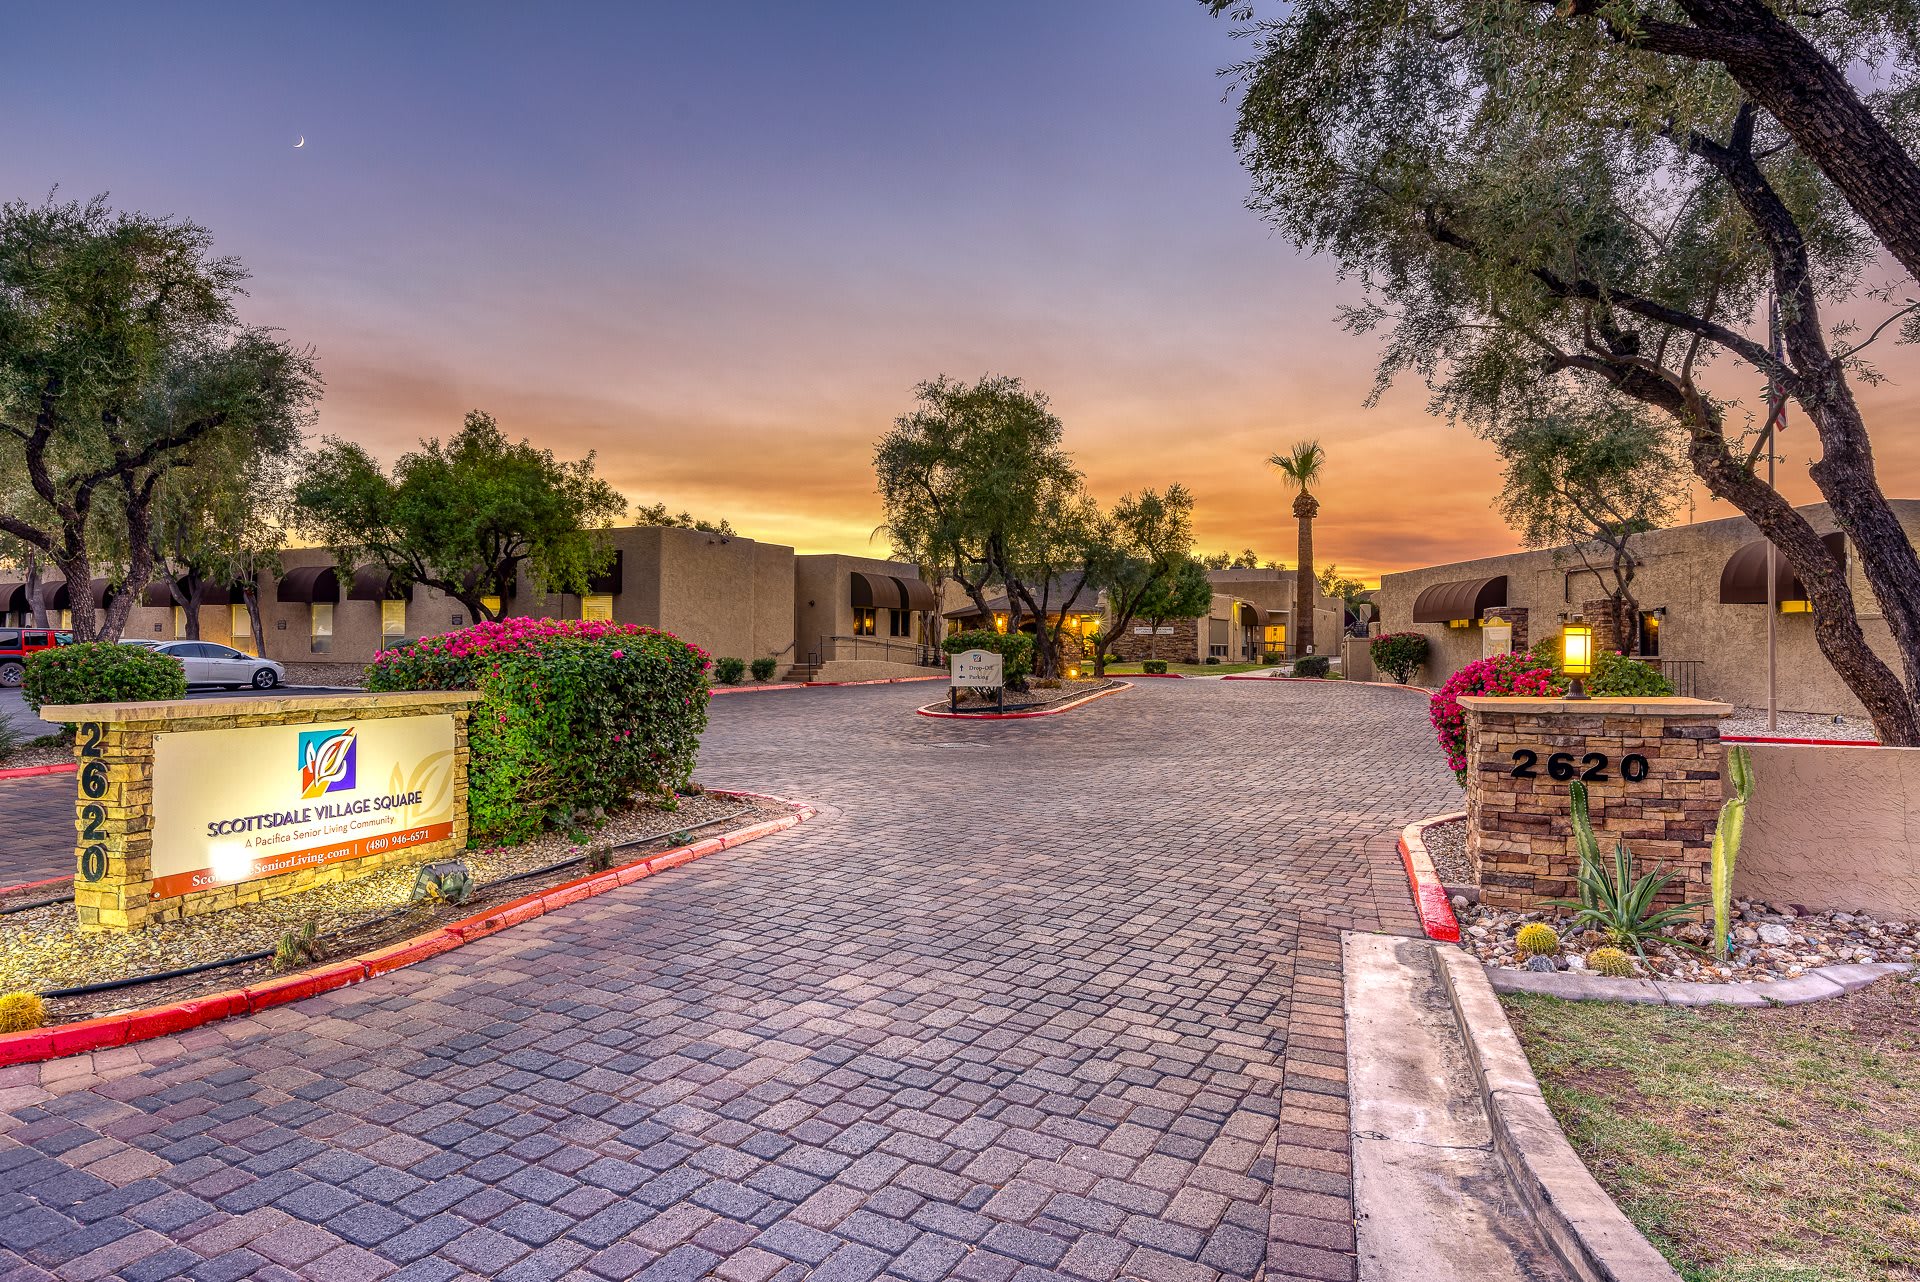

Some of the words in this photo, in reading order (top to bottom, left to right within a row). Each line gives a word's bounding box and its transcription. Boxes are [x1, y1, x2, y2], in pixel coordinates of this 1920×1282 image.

[1510, 749, 1649, 782] 2620
[81, 722, 108, 882] 2620
[207, 807, 312, 838] SCOTTSDALE
[314, 798, 371, 821] VILLAGE
[373, 790, 423, 811] SQUARE
[244, 838, 253, 849] A
[255, 833, 291, 848] Pacifica
[293, 828, 322, 841] Senior
[323, 822, 348, 835] Living
[349, 815, 395, 830] Community
[365, 837, 389, 853] (480)
[391, 829, 430, 846] 946-6571
